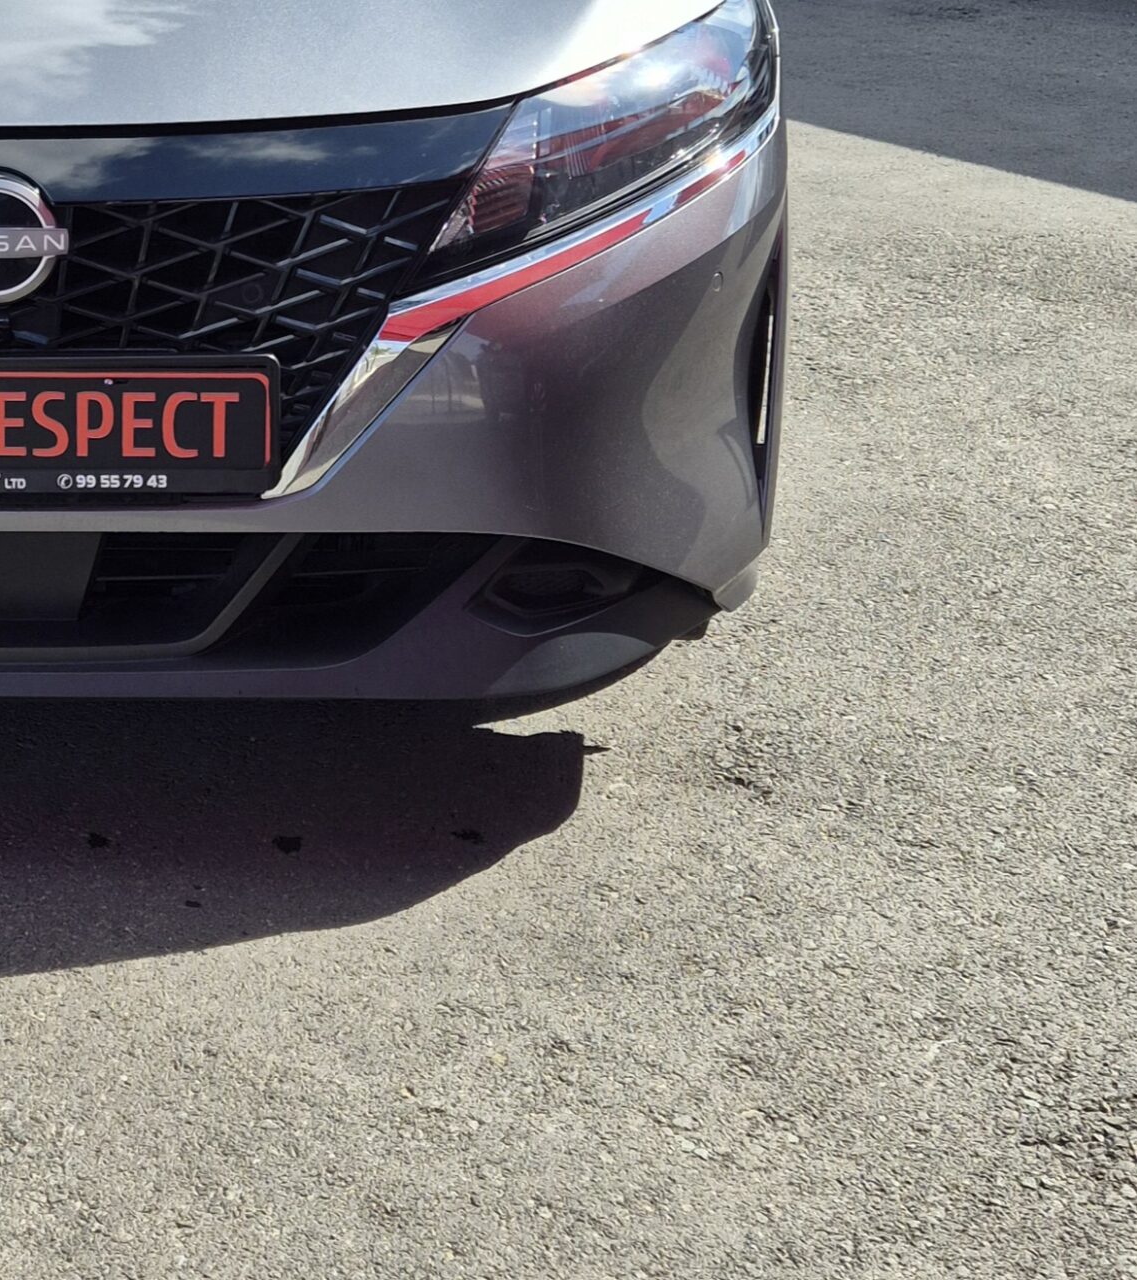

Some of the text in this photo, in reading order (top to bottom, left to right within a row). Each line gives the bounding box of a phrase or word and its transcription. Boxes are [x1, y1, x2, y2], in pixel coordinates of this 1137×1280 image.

[4, 477, 27, 490] LTD
[76, 474, 96, 489] 99
[100, 474, 120, 489] 55
[123, 474, 143, 489] 79
[146, 474, 168, 489] 43
